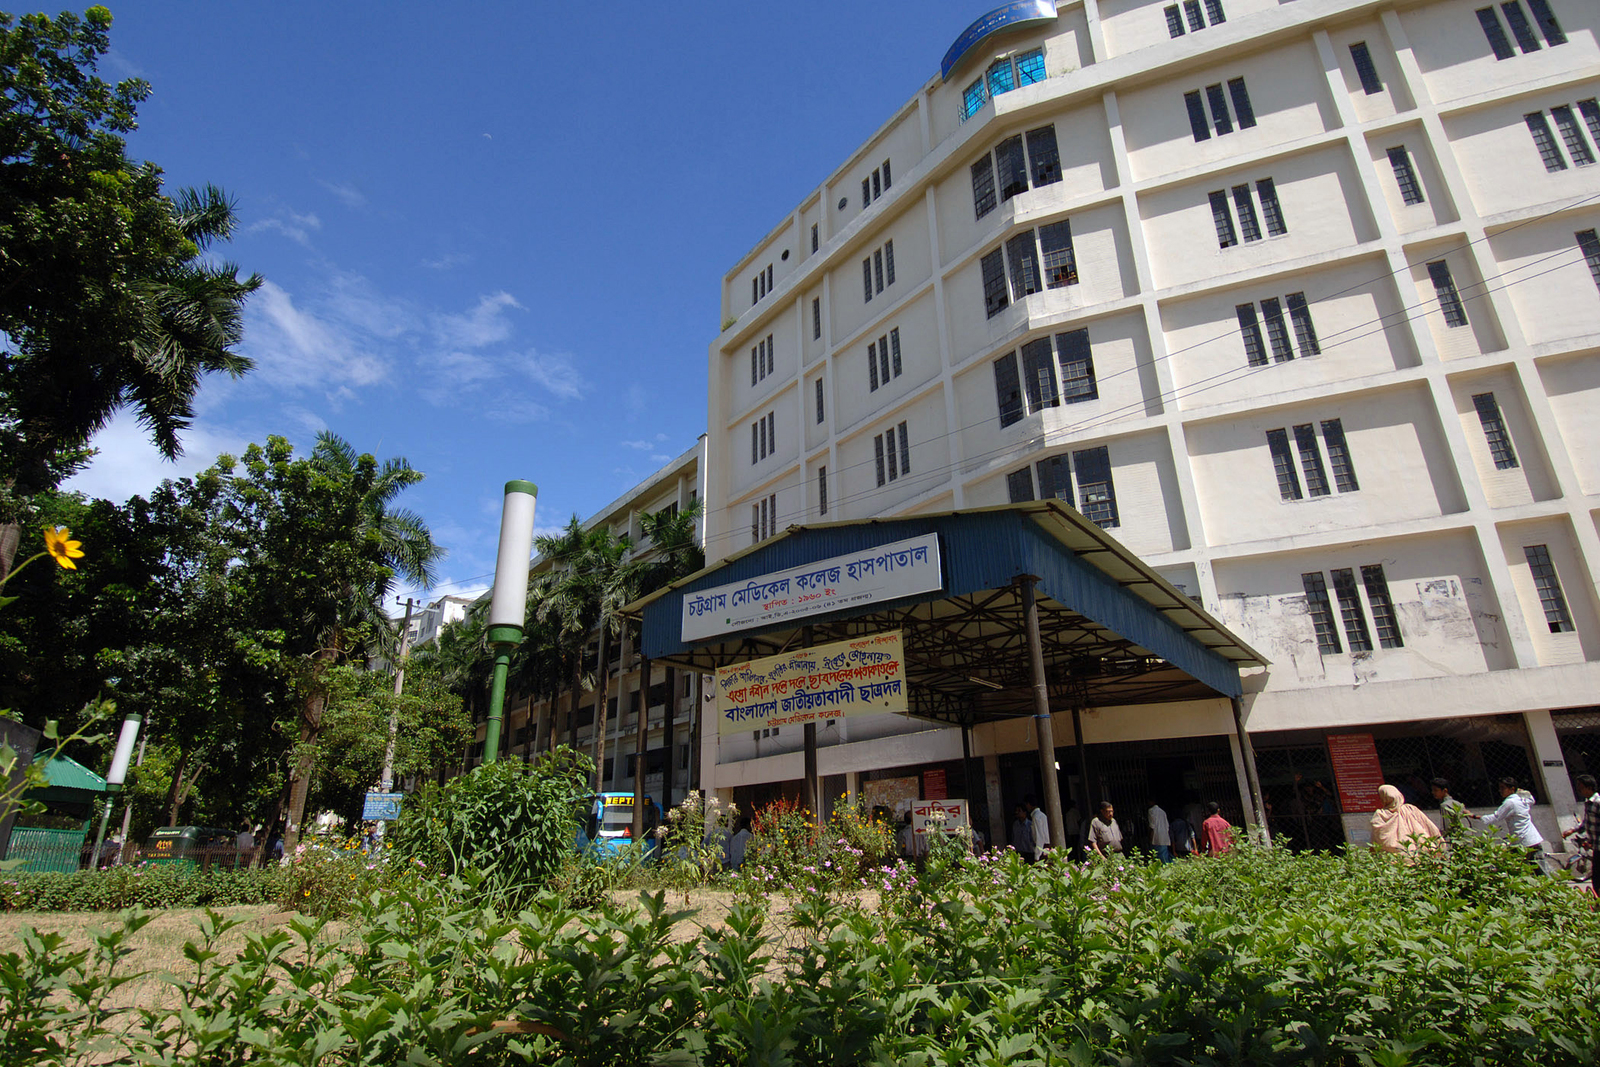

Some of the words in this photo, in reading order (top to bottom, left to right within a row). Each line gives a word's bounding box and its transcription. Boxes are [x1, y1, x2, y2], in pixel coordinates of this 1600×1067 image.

[688, 593, 727, 617] চট্টগ্রাম
[732, 578, 791, 607] মেডিকেল
[795, 566, 842, 590] কলেজ
[846, 545, 929, 582] হাসপাতাল
[762, 599, 788, 611] স্থাপিত
[798, 592, 822, 604] ১৯৬০
[724, 699, 777, 721] বাংলাদেশ
[781, 682, 855, 711] জাতীয়তাবাদী
[857, 679, 903, 704] ছাত্রদল
[725, 687, 748, 703] এসো
[749, 684, 770, 700] নবীন
[771, 680, 788, 694] দলে
[788, 675, 807, 689] দলে
[808, 667, 854, 690] ছাত্রদলের
[605, 797, 650, 806] NEPTE
